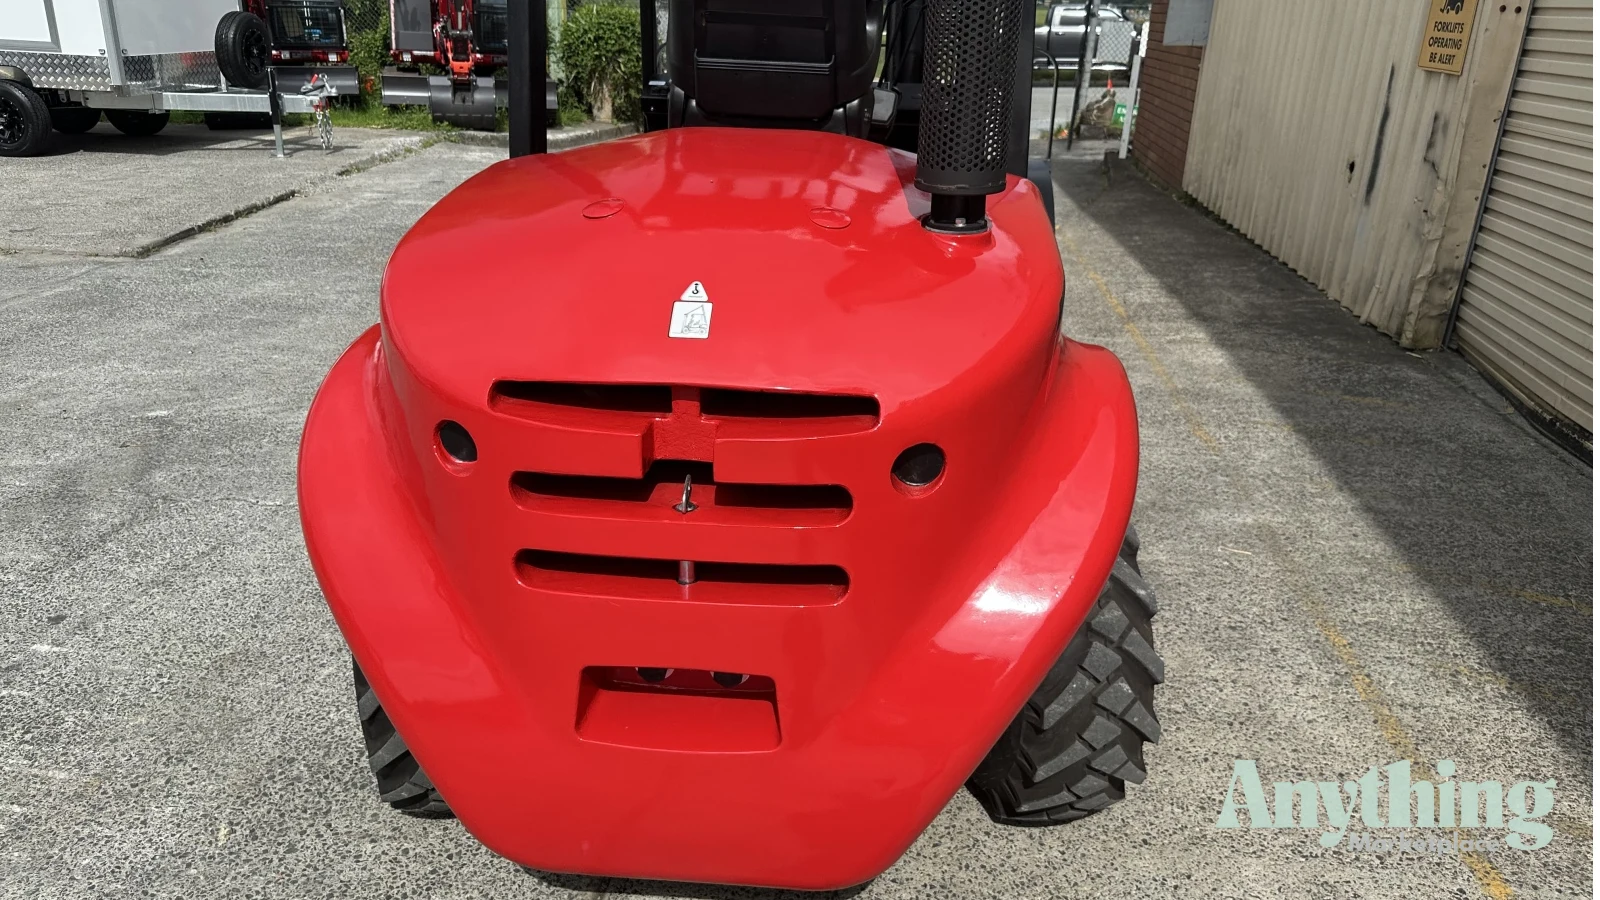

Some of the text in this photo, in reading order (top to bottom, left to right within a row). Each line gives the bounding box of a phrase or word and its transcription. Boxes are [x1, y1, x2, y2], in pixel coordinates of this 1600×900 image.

[1433, 21, 1464, 34] FORKLIFTS
[1428, 36, 1462, 50] OPERATING
[1428, 52, 1456, 65] BE ALERT
